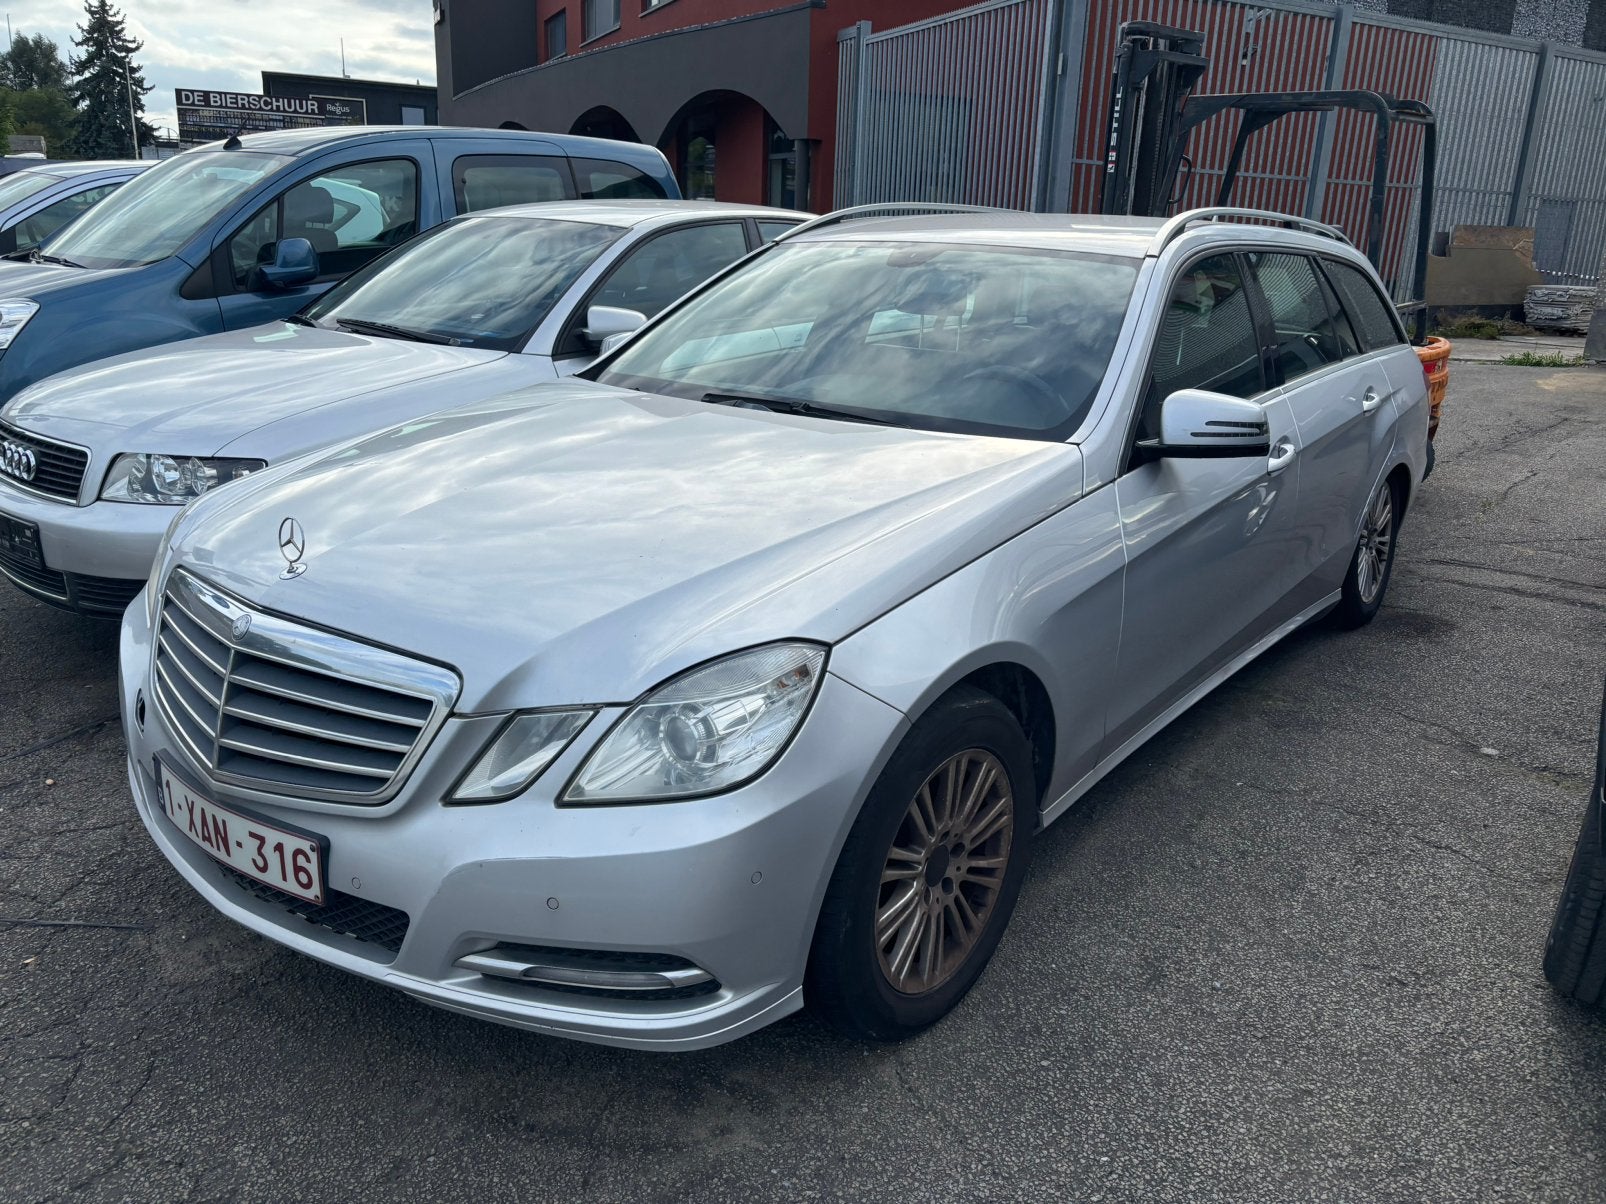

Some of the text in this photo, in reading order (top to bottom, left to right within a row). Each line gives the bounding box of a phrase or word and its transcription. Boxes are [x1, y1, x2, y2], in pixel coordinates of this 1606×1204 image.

[181, 91, 319, 114] DE BIERSCHUUR
[326, 103, 350, 115] Regus
[1110, 86, 1123, 146] STILL
[165, 778, 314, 891] 1-XAN-316
